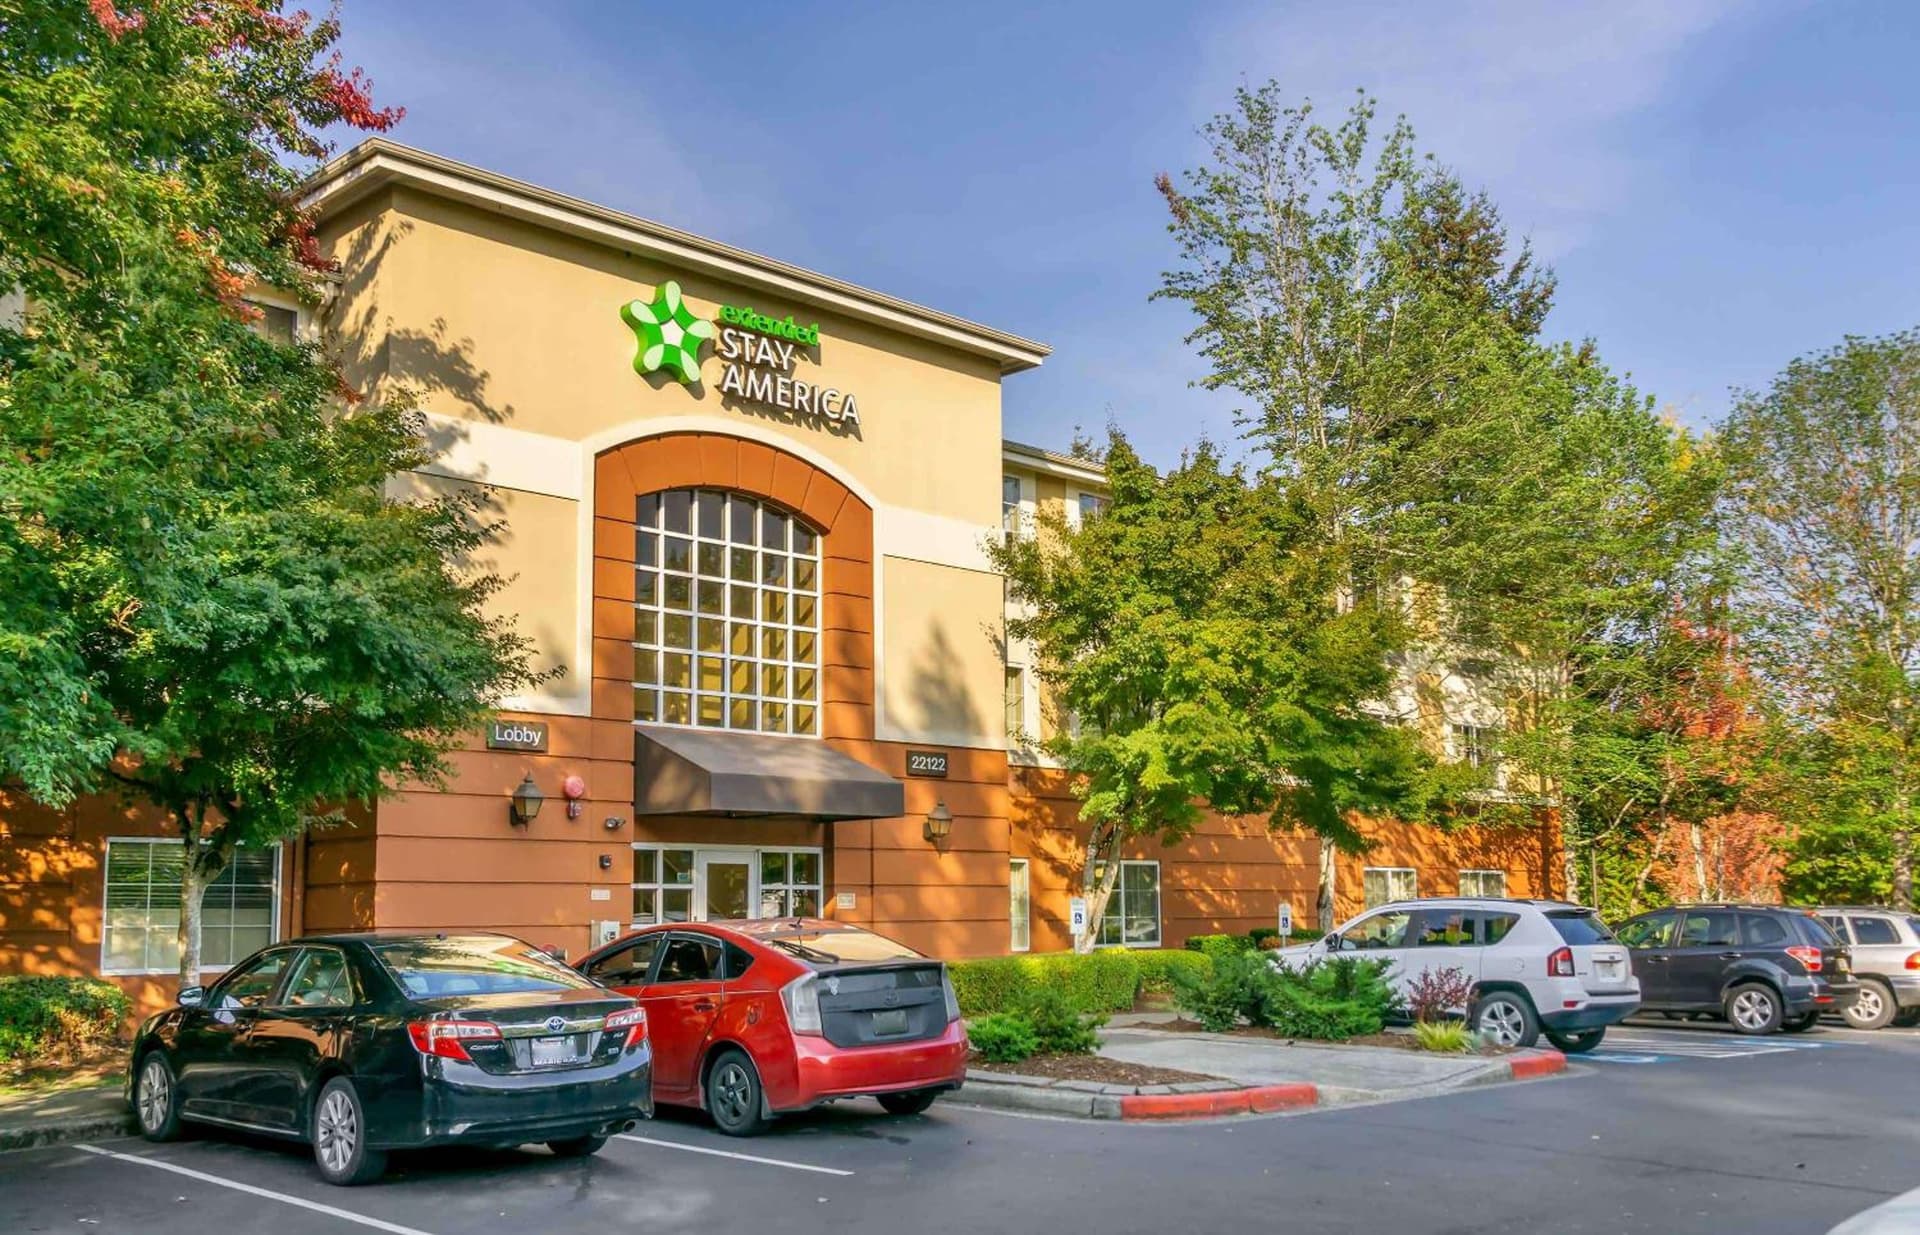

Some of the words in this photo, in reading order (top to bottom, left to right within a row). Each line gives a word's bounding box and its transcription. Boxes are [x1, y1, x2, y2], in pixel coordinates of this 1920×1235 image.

[720, 304, 820, 346] extended
[722, 328, 794, 371] STAY
[722, 364, 860, 425] AMERICA
[495, 724, 542, 747] Lobby
[911, 755, 946, 771] 22122
